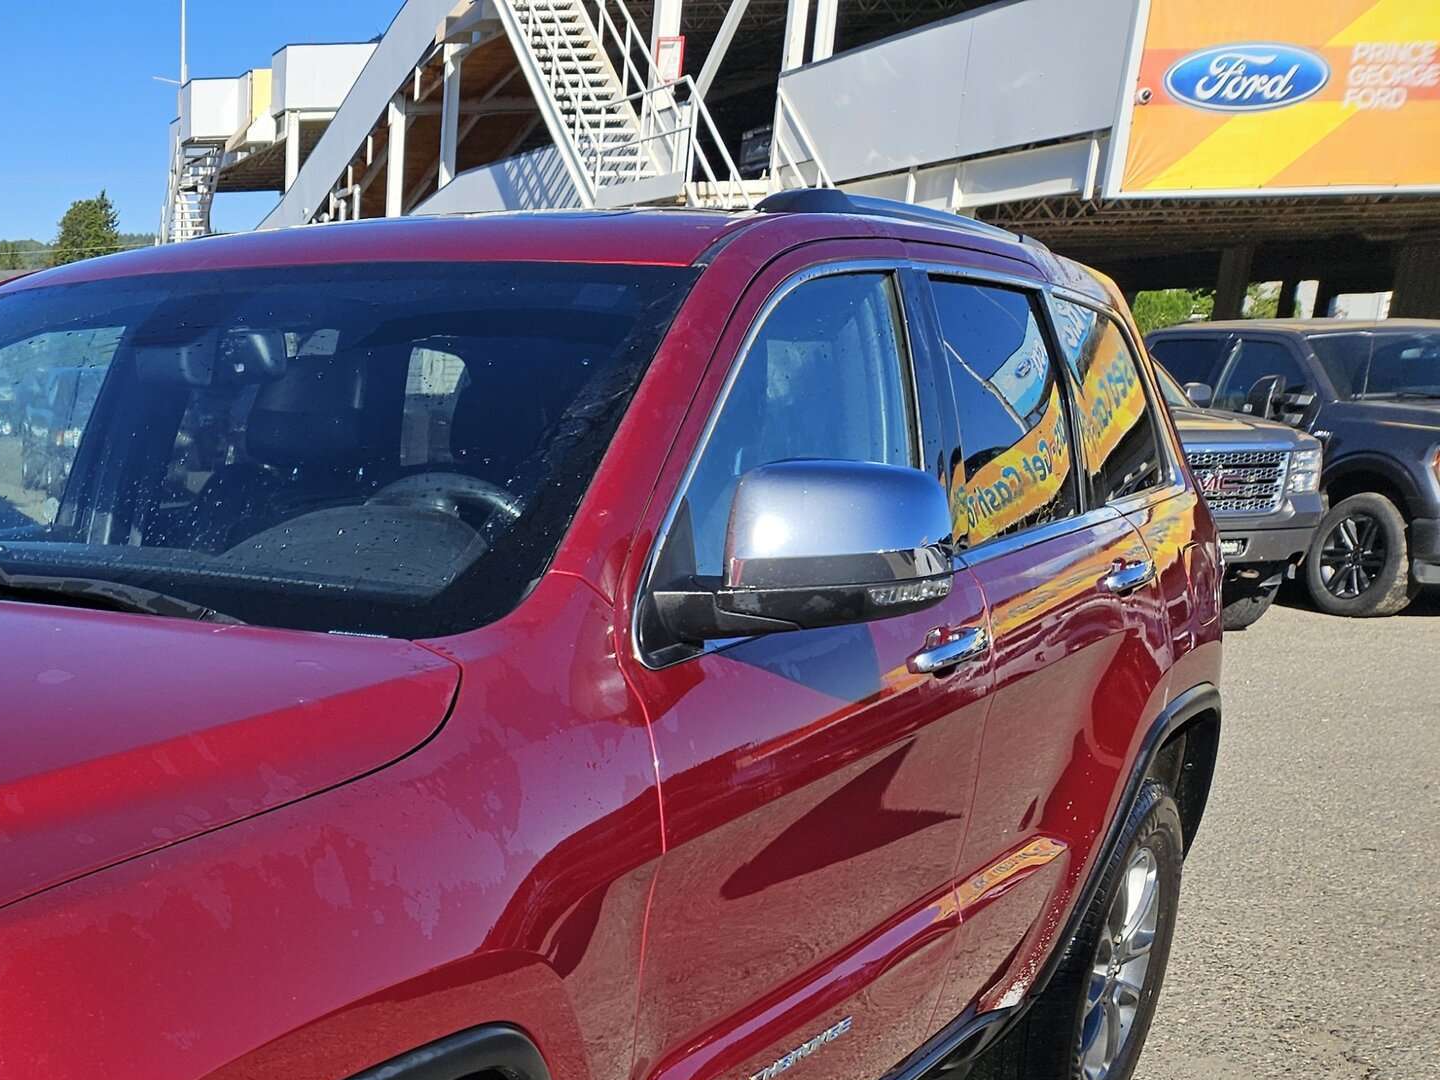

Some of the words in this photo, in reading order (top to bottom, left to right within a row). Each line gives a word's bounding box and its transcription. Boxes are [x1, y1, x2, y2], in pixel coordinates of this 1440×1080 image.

[1350, 42, 1439, 65] PRINCE
[1195, 53, 1300, 101] Ford
[1346, 64, 1440, 87] GEORGE
[1342, 88, 1408, 110] FORD
